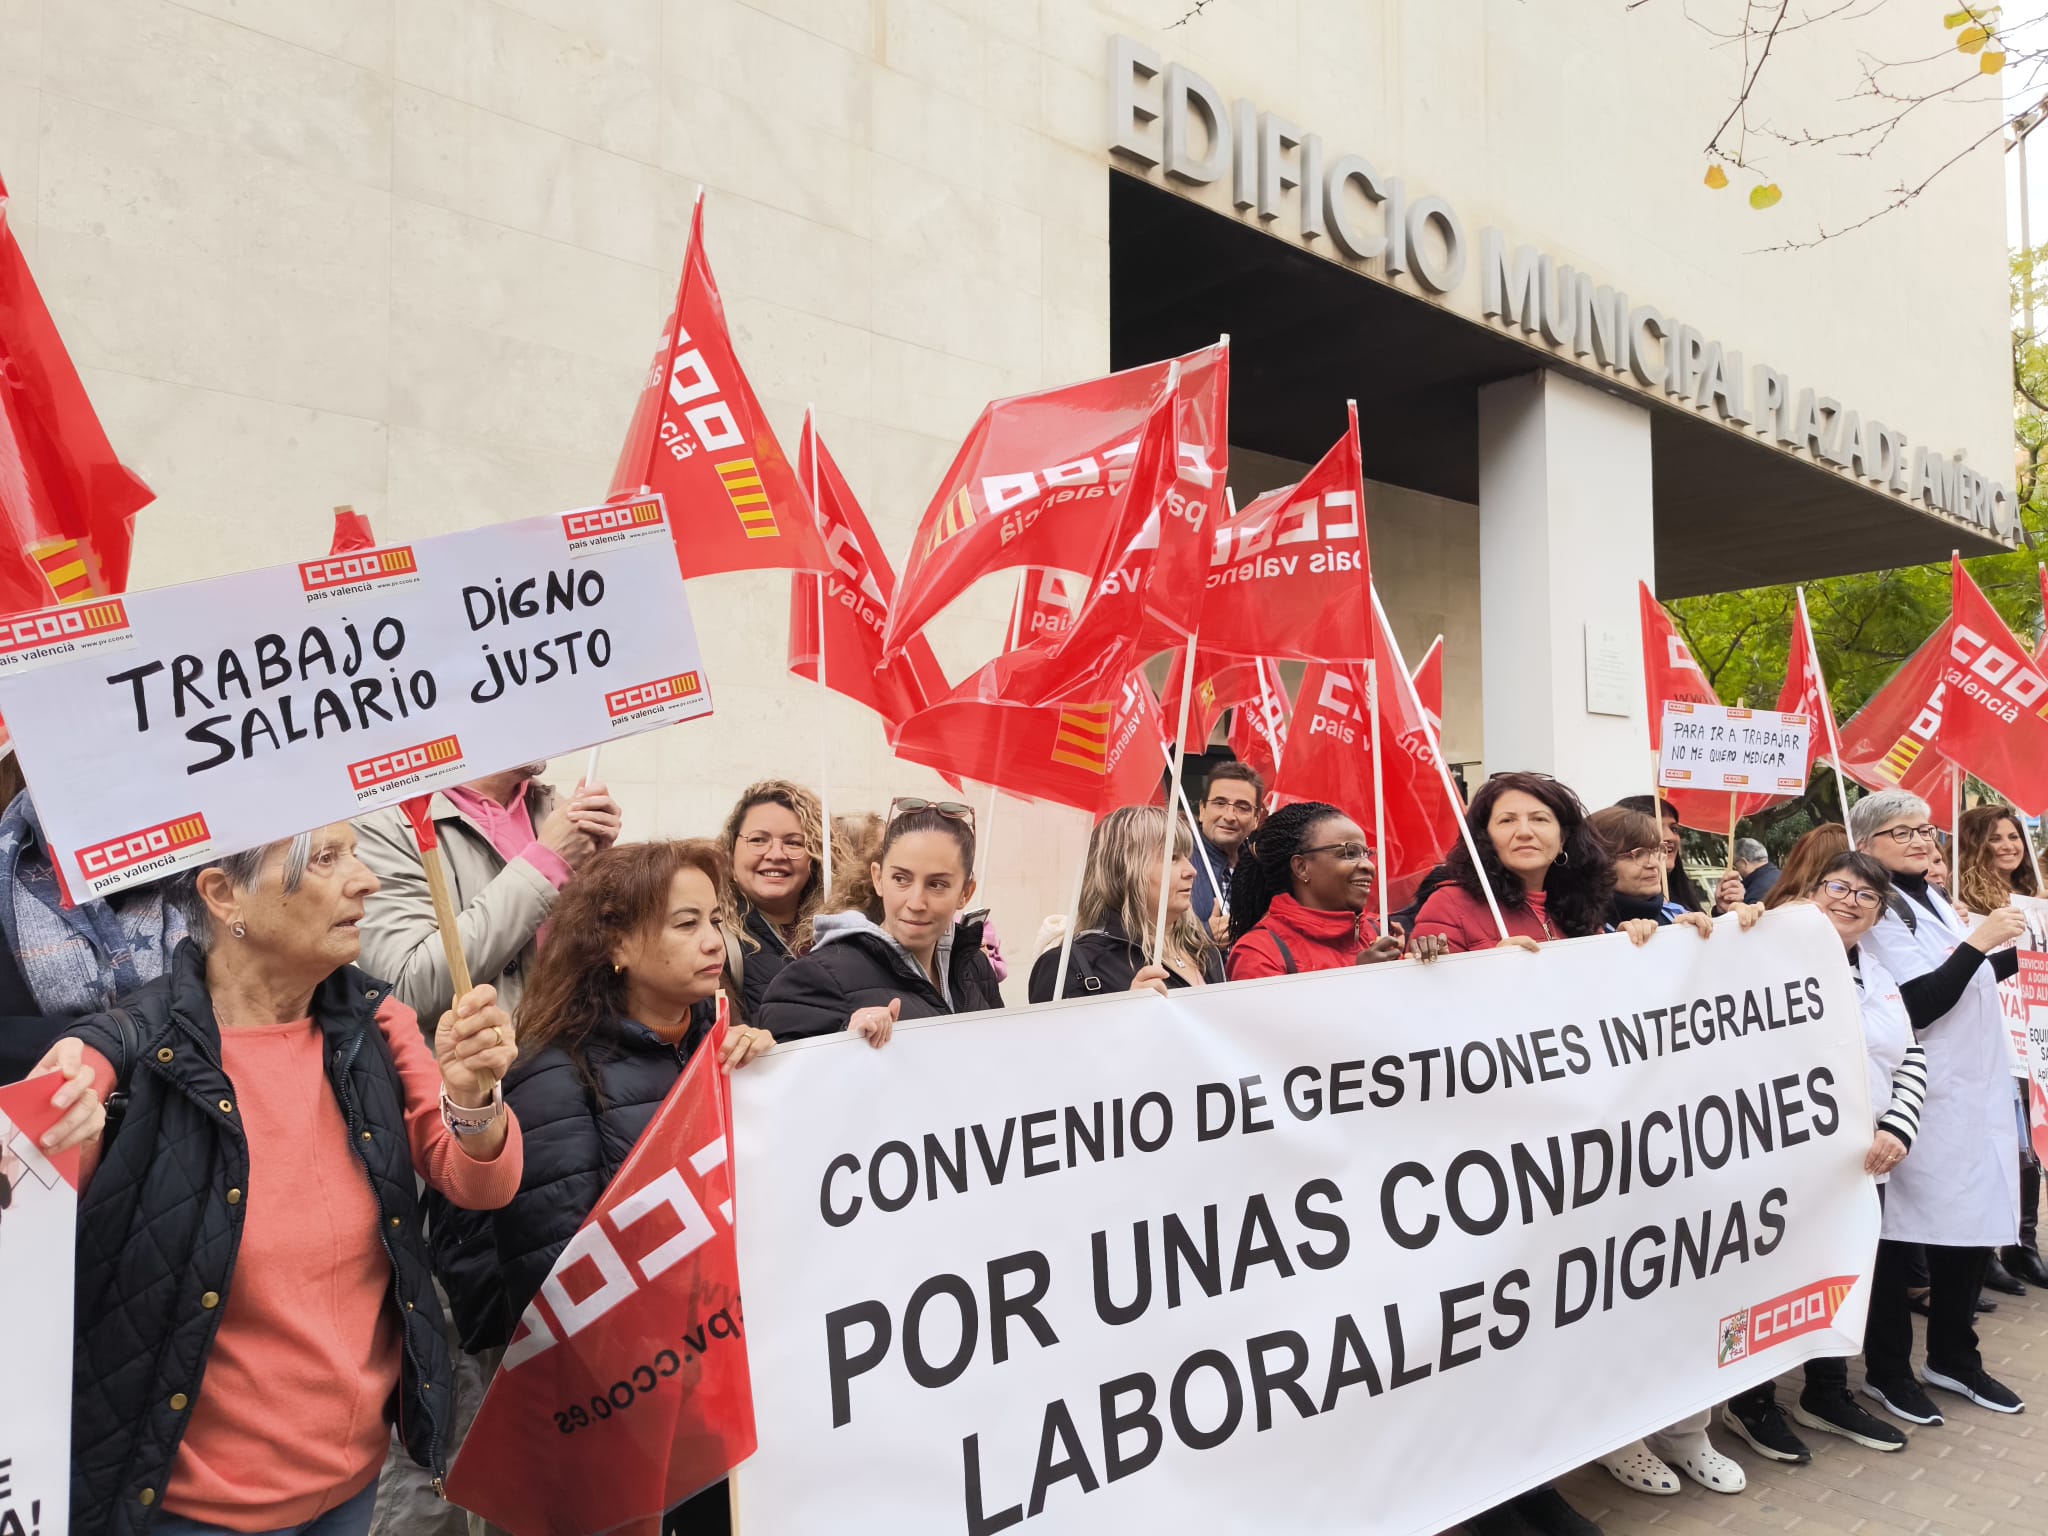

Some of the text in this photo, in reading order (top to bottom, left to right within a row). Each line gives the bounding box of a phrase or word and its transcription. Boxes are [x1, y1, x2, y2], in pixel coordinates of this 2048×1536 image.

[1108, 33, 2026, 546] EDIFICIO MUNICIPAL PLAZA DE AMÉRICA
[567, 508, 634, 535] CCOO
[589, 532, 627, 547] valencià
[304, 555, 382, 586] CCOO
[331, 582, 373, 598] valencià
[21, 641, 76, 661] valencià
[106, 568, 606, 733] TRABAJO DIGNO
[609, 681, 673, 712] CCOO
[185, 667, 437, 776] SALARIO
[630, 705, 666, 720] valencià
[1309, 714, 1356, 745] país
[1673, 722, 1800, 751] PARA IR A TRABAJAR
[353, 748, 429, 784] CCOO
[1672, 746, 1786, 768] NO ME QUIERO MEDICAR
[380, 774, 421, 792] valencià
[82, 828, 170, 873] CCOO
[94, 874, 121, 892] país
[123, 853, 177, 879] valencià
[820, 976, 1825, 1227] CONVENIO DE GESTIONES INTEGRALES
[825, 1066, 1840, 1429] POR UNAS CONDICIONES
[1754, 1291, 1826, 1342] CCOO
[962, 1187, 1788, 1536] LABORALES DIGNAS
